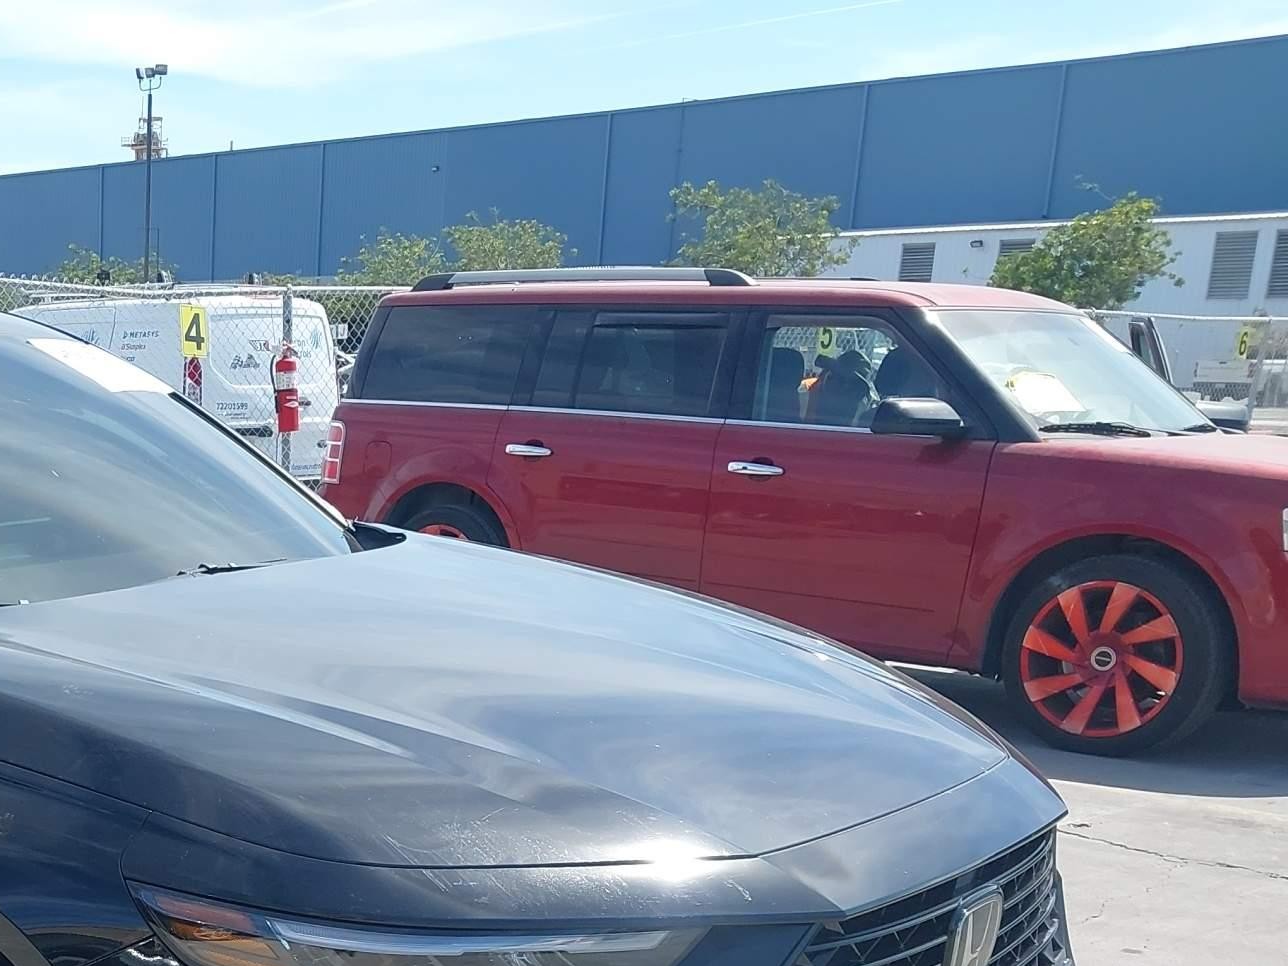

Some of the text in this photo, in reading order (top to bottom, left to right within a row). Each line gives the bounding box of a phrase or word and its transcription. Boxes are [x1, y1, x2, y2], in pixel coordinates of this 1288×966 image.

[185, 313, 204, 350] 4
[821, 327, 832, 349] 5
[1239, 331, 1248, 356] 6
